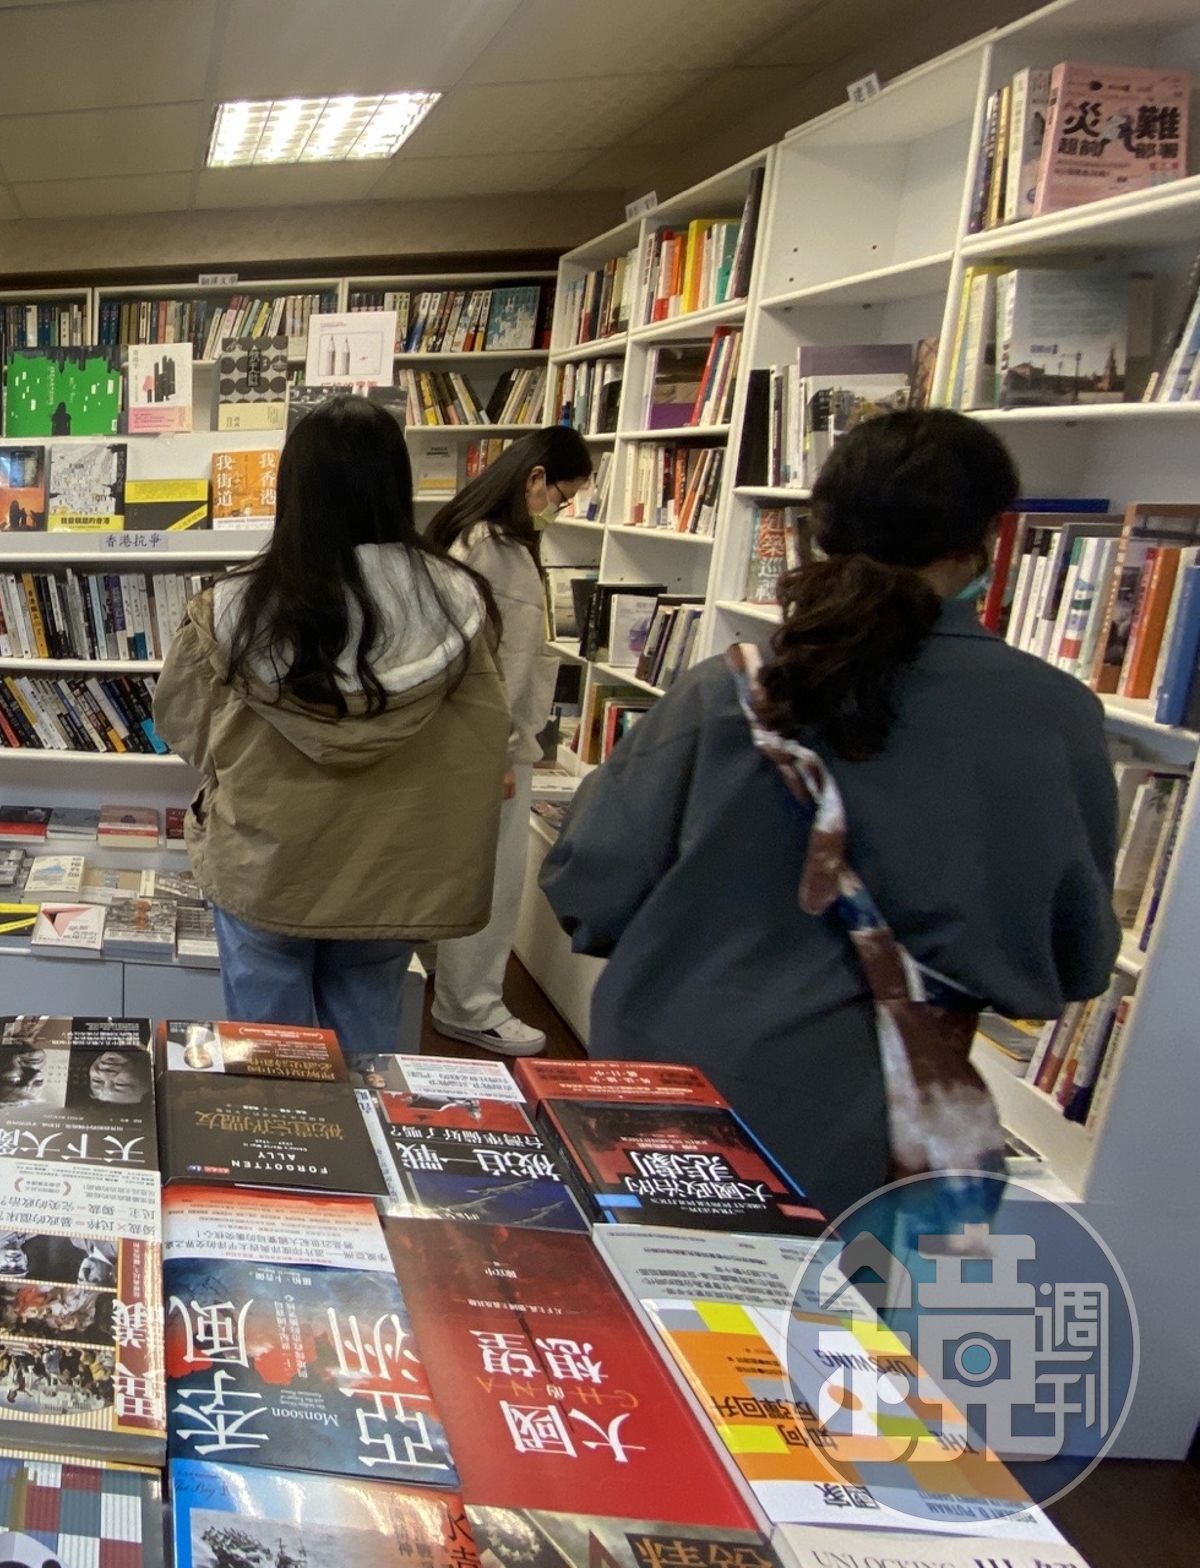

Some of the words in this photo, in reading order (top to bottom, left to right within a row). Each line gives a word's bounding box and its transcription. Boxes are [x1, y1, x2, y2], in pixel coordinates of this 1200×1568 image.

[104, 534, 163, 549] 香港抗爭
[195, 1111, 344, 1141] 被遺忘的盟友
[231, 1159, 328, 1175] FORGOTTEN
[257, 1151, 296, 1161] ALLY
[394, 1141, 561, 1181] 被迫一戰
[628, 1151, 730, 1182] 悲劇
[624, 1175, 773, 1203] 大國政治的
[469, 1329, 609, 1384] 想望
[813, 1348, 917, 1378] UPSWING
[167, 1296, 270, 1455] 季風
[327, 1306, 450, 1471] 亞洲
[546, 1383, 565, 1400] 的
[270, 1406, 340, 1427] Monsoon
[499, 1400, 647, 1464] 大國
[813, 1482, 880, 1510] 國家
